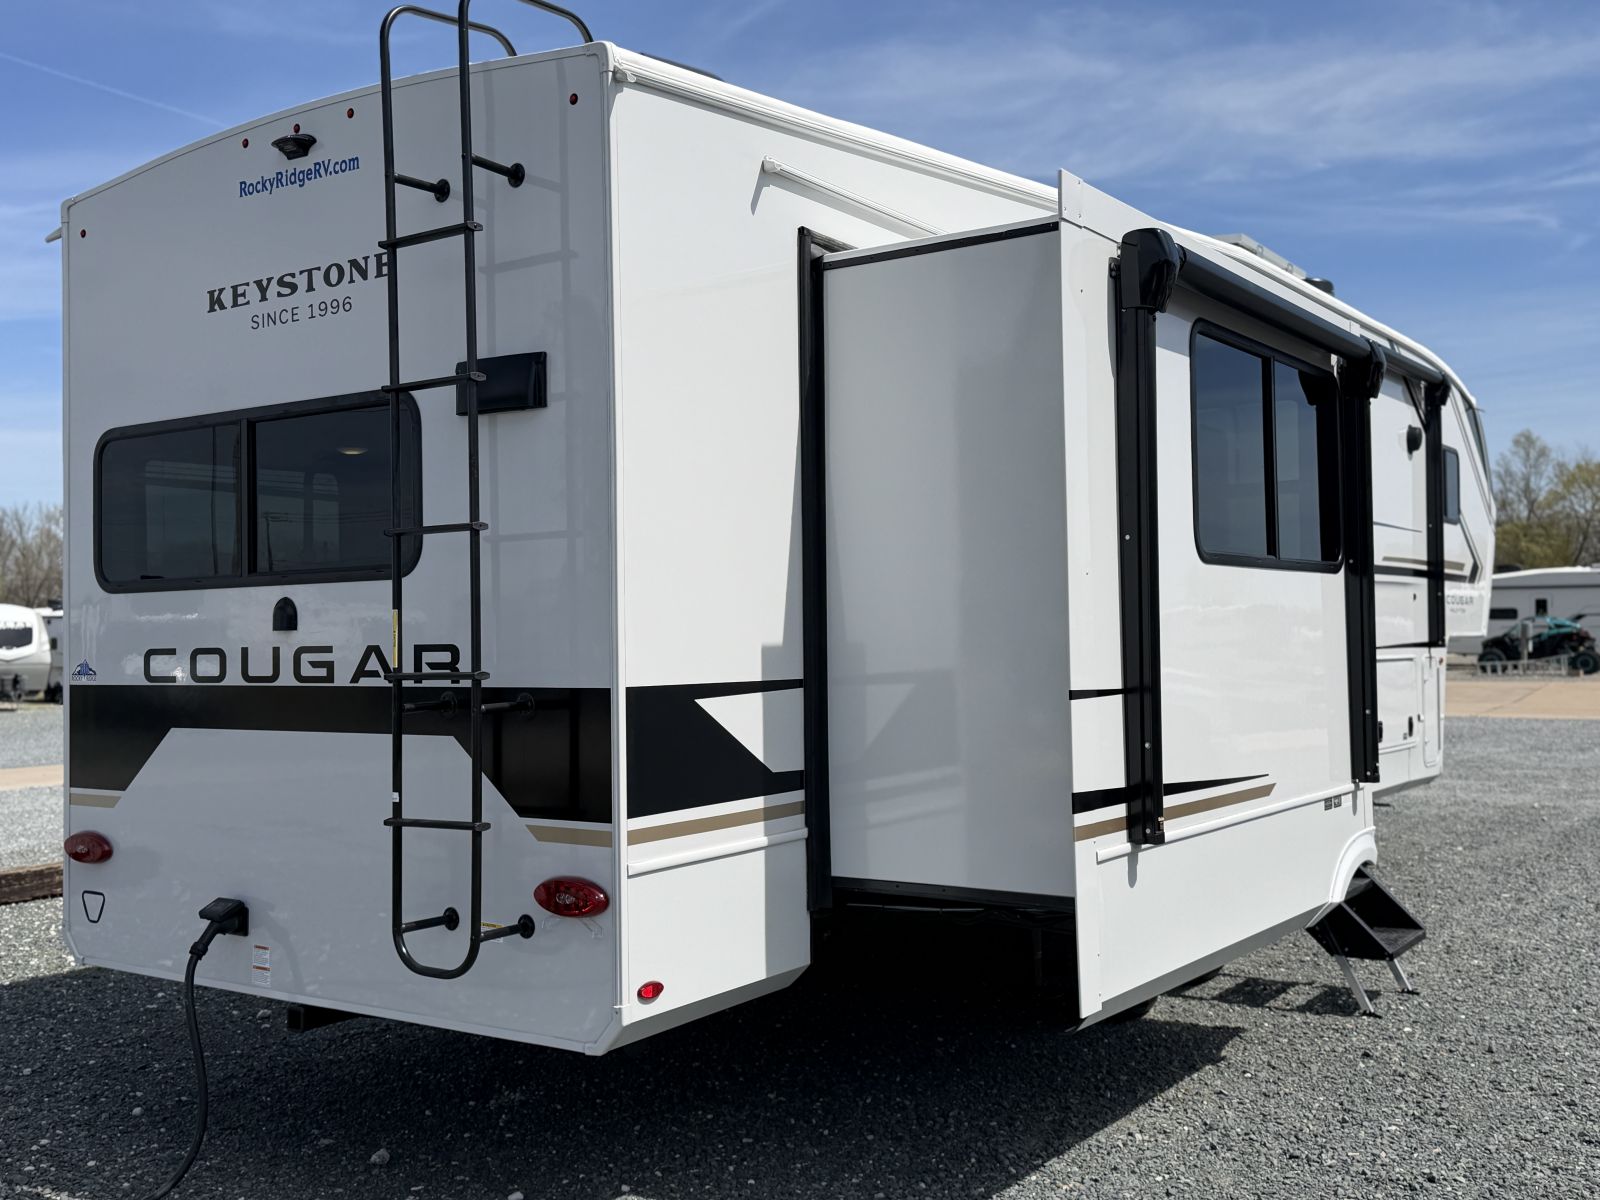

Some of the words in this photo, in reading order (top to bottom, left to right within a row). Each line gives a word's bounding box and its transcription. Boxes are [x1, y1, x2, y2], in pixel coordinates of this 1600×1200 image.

[239, 156, 360, 197] RockyRidgeRV.com
[207, 251, 389, 313] KEYSTONE
[251, 306, 300, 330] SINCE
[308, 296, 353, 319] 1996
[143, 644, 460, 684] COUGAR
